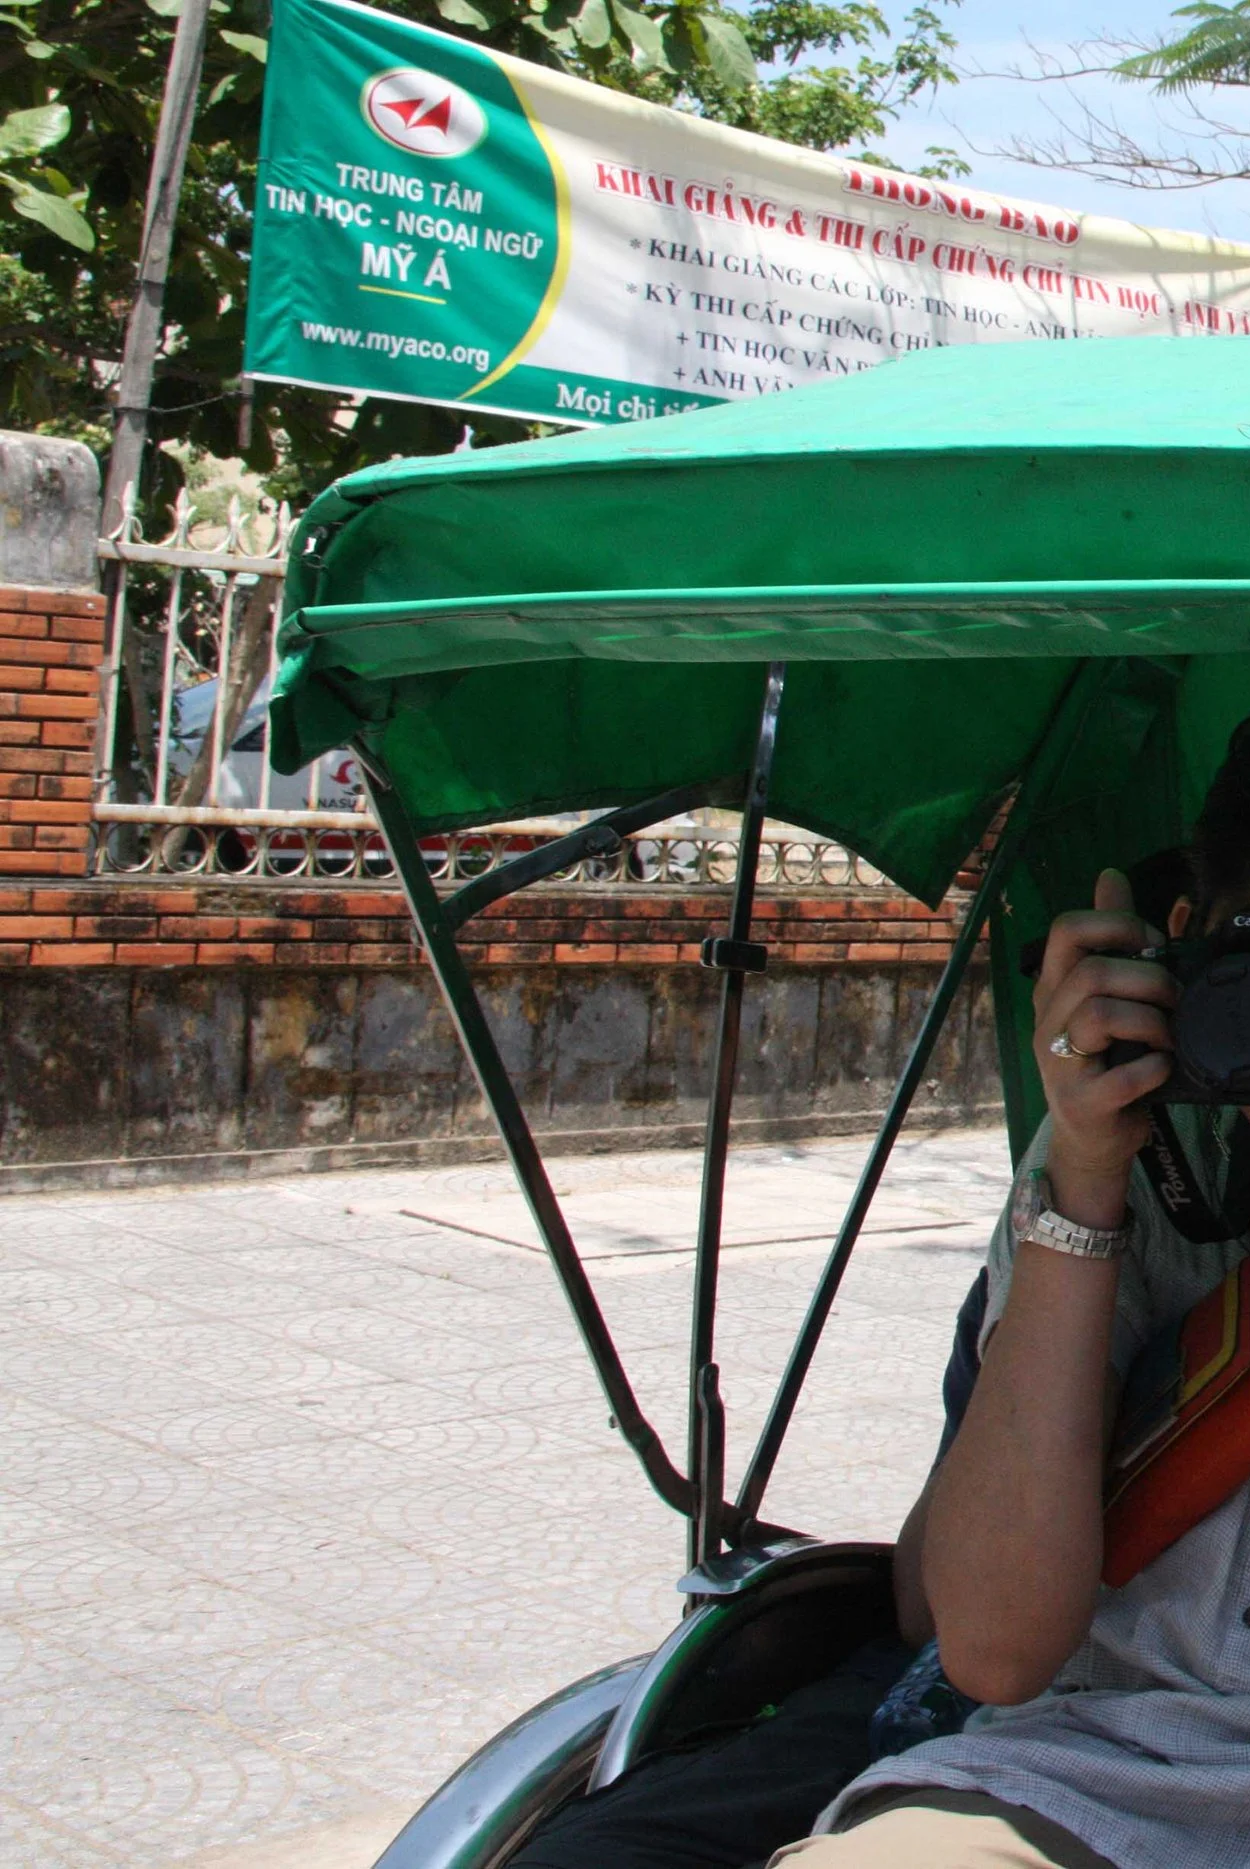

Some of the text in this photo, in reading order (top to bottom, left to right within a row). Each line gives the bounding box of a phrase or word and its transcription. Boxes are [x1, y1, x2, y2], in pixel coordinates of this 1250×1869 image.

[336, 161, 484, 214] TRUNG TÂM
[264, 183, 307, 215] TIN
[313, 193, 373, 228] HỌC
[396, 209, 479, 251] NGOẠI
[484, 227, 544, 260] NGỮ
[594, 162, 676, 207] KHAI
[683, 180, 778, 230] GIẢNG
[784, 208, 807, 238] &
[816, 213, 866, 251] THI
[871, 221, 927, 263] CẤP
[932, 242, 1016, 284] CHỨNG
[1022, 260, 1063, 295] CHỈ
[1070, 275, 1111, 304] TIN
[1117, 285, 1163, 319] HỌC
[1181, 300, 1220, 331] ANH
[361, 241, 452, 291] MỸ Á
[647, 237, 716, 269] KHAI
[722, 253, 803, 286] GIẢNG
[811, 270, 859, 298] CÁC
[866, 283, 915, 310] LỚP:
[921, 296, 957, 319] TIN
[964, 305, 1008, 329] HỌC
[1024, 319, 1066, 340] ANH
[690, 291, 737, 317] THI
[742, 299, 793, 327] CẤP
[799, 314, 883, 345] CHỨNG
[301, 320, 490, 373] www.myaco.org
[695, 330, 737, 354] TIN
[744, 339, 796, 366] HỌC
[802, 350, 849, 375] VĂN
[555, 383, 612, 418] Mọi
[617, 395, 656, 422] chi
[692, 367, 747, 392] ANH
